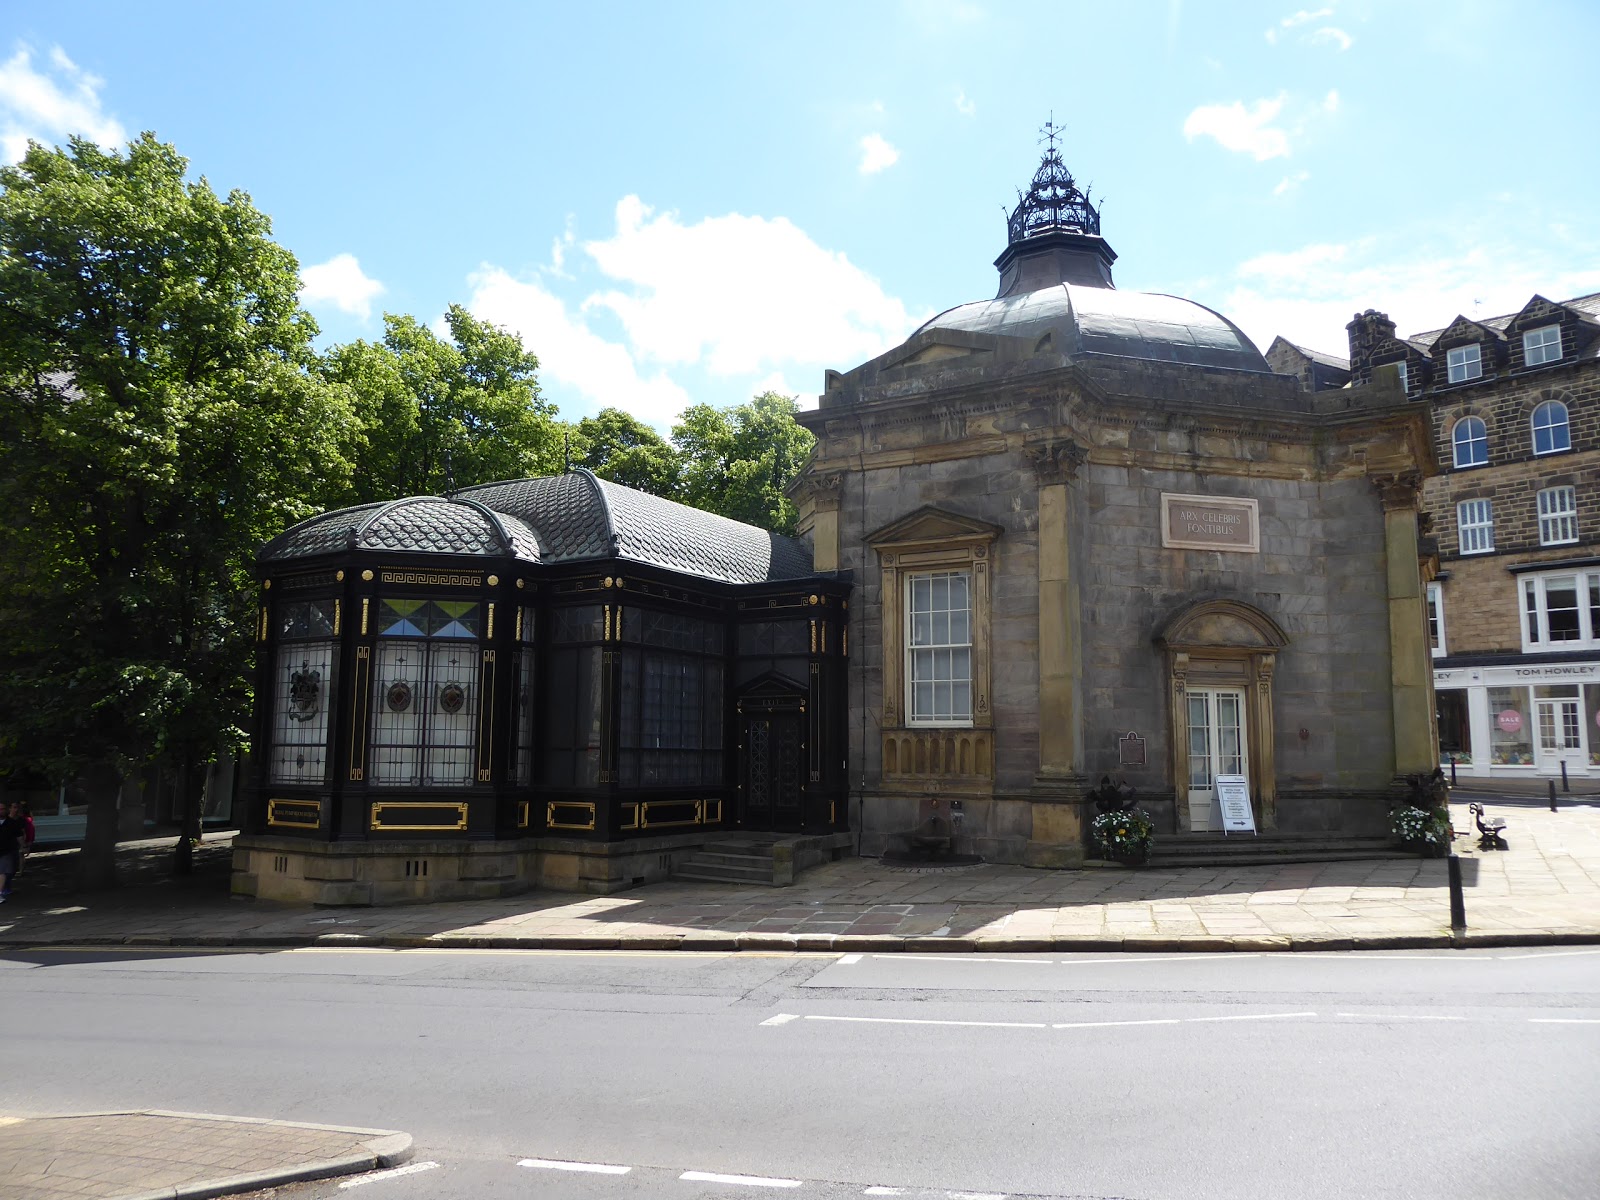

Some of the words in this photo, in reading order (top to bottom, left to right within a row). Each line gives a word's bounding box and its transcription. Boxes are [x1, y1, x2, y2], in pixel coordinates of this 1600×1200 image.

[1179, 511, 1198, 521] ARX
[1202, 512, 1241, 525] CELEBRIS
[1187, 523, 1234, 535] FONTIBUS
[1544, 666, 1596, 675] HOWLEY
